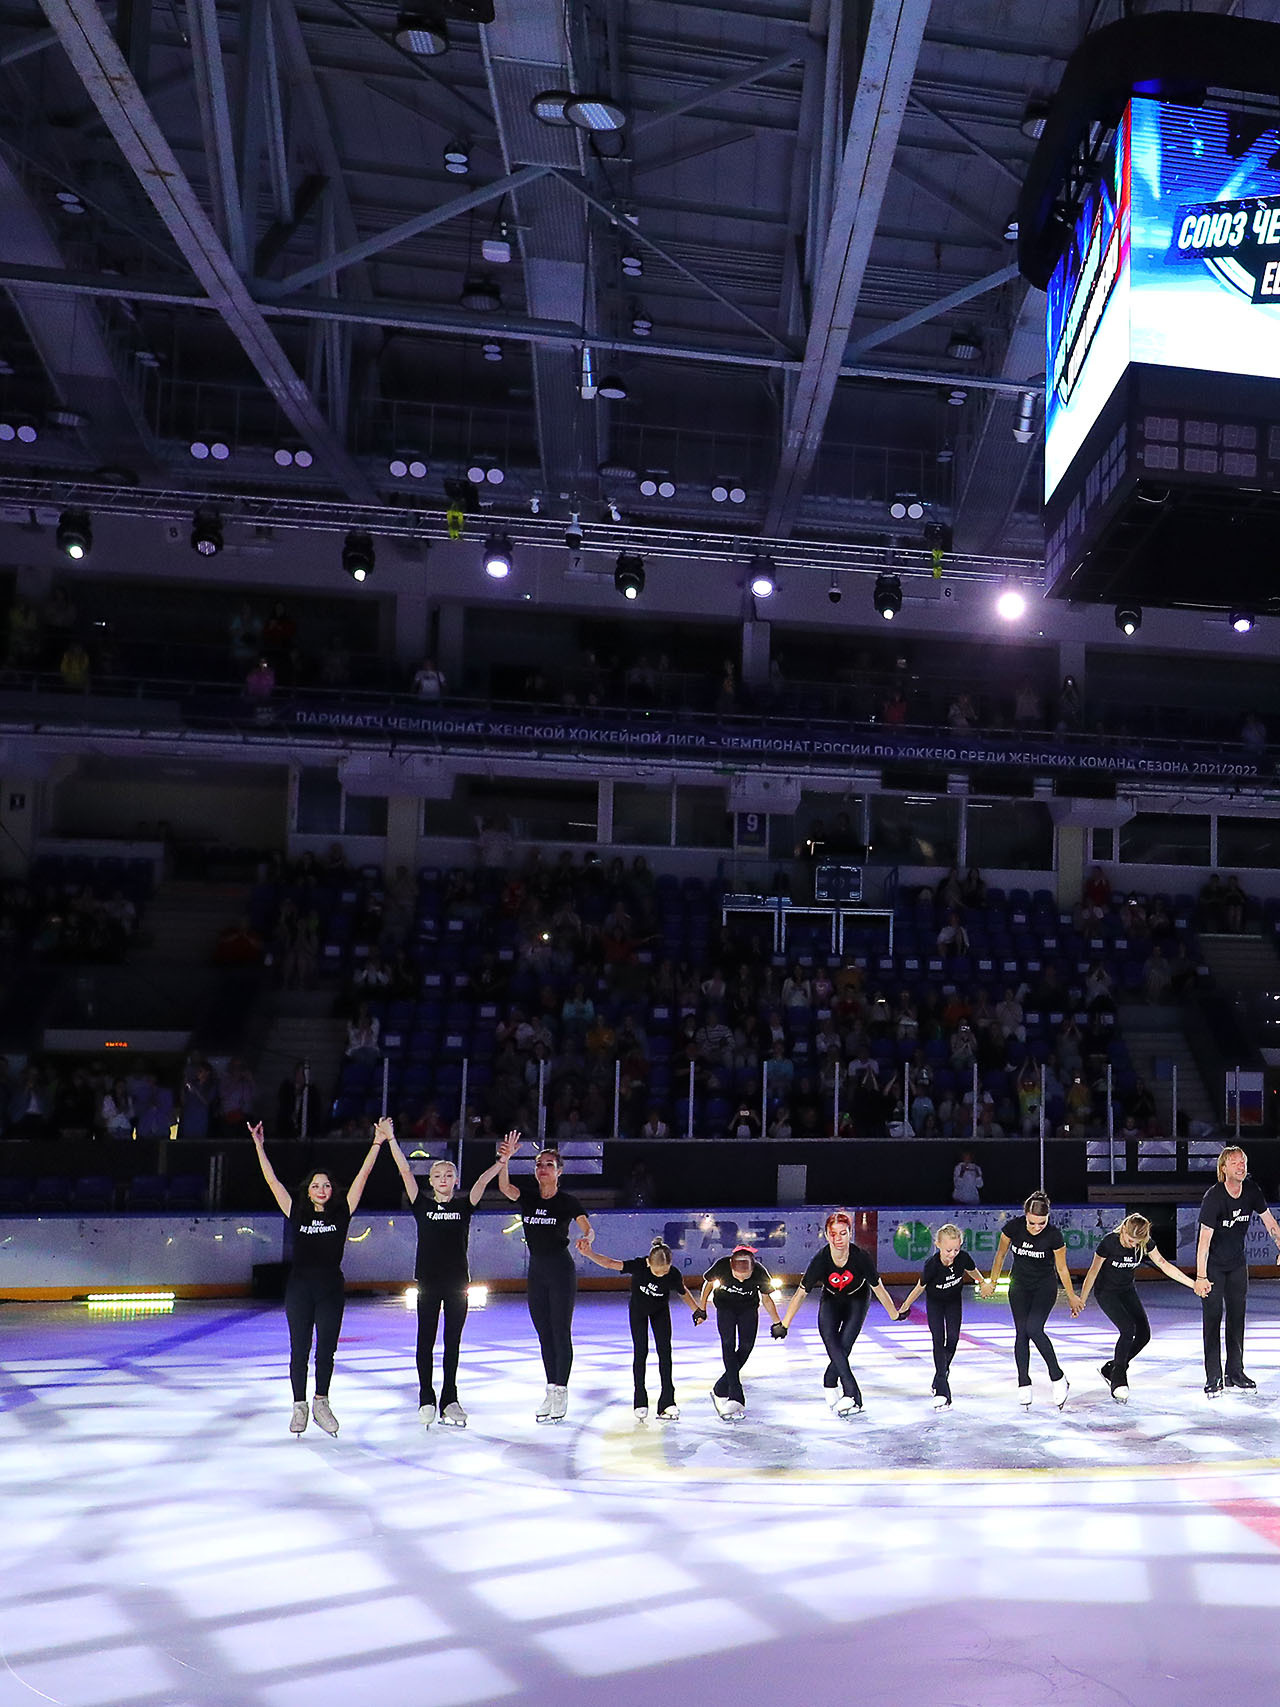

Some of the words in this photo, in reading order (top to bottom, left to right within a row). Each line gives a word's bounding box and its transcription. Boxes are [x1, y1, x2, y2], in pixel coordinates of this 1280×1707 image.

[1177, 211, 1249, 250] СОЮЗ
[296, 711, 383, 729] ПАРИМАТЧ
[387, 717, 485, 734] ЧЕМПИОНАТ
[488, 722, 565, 740] ЖЕНСКОЙ
[568, 727, 662, 744] ХОККЕЙНОЙ
[665, 733, 706, 746] ЛИГИ
[720, 737, 812, 753] ЧЕМПИОНАТ
[813, 742, 871, 755] РОССИИ
[873, 745, 895, 756] ПО
[896, 746, 957, 760] ХОККЕЮ
[959, 749, 1006, 762] СРЕДИ
[1008, 752, 1076, 766] ЖЕНСКИХ
[1079, 755, 1137, 770] КОМАНД
[1138, 760, 1189, 773] СЕЗОНА
[1192, 762, 1258, 776] 2021/2022
[746, 813, 759, 832] 9
